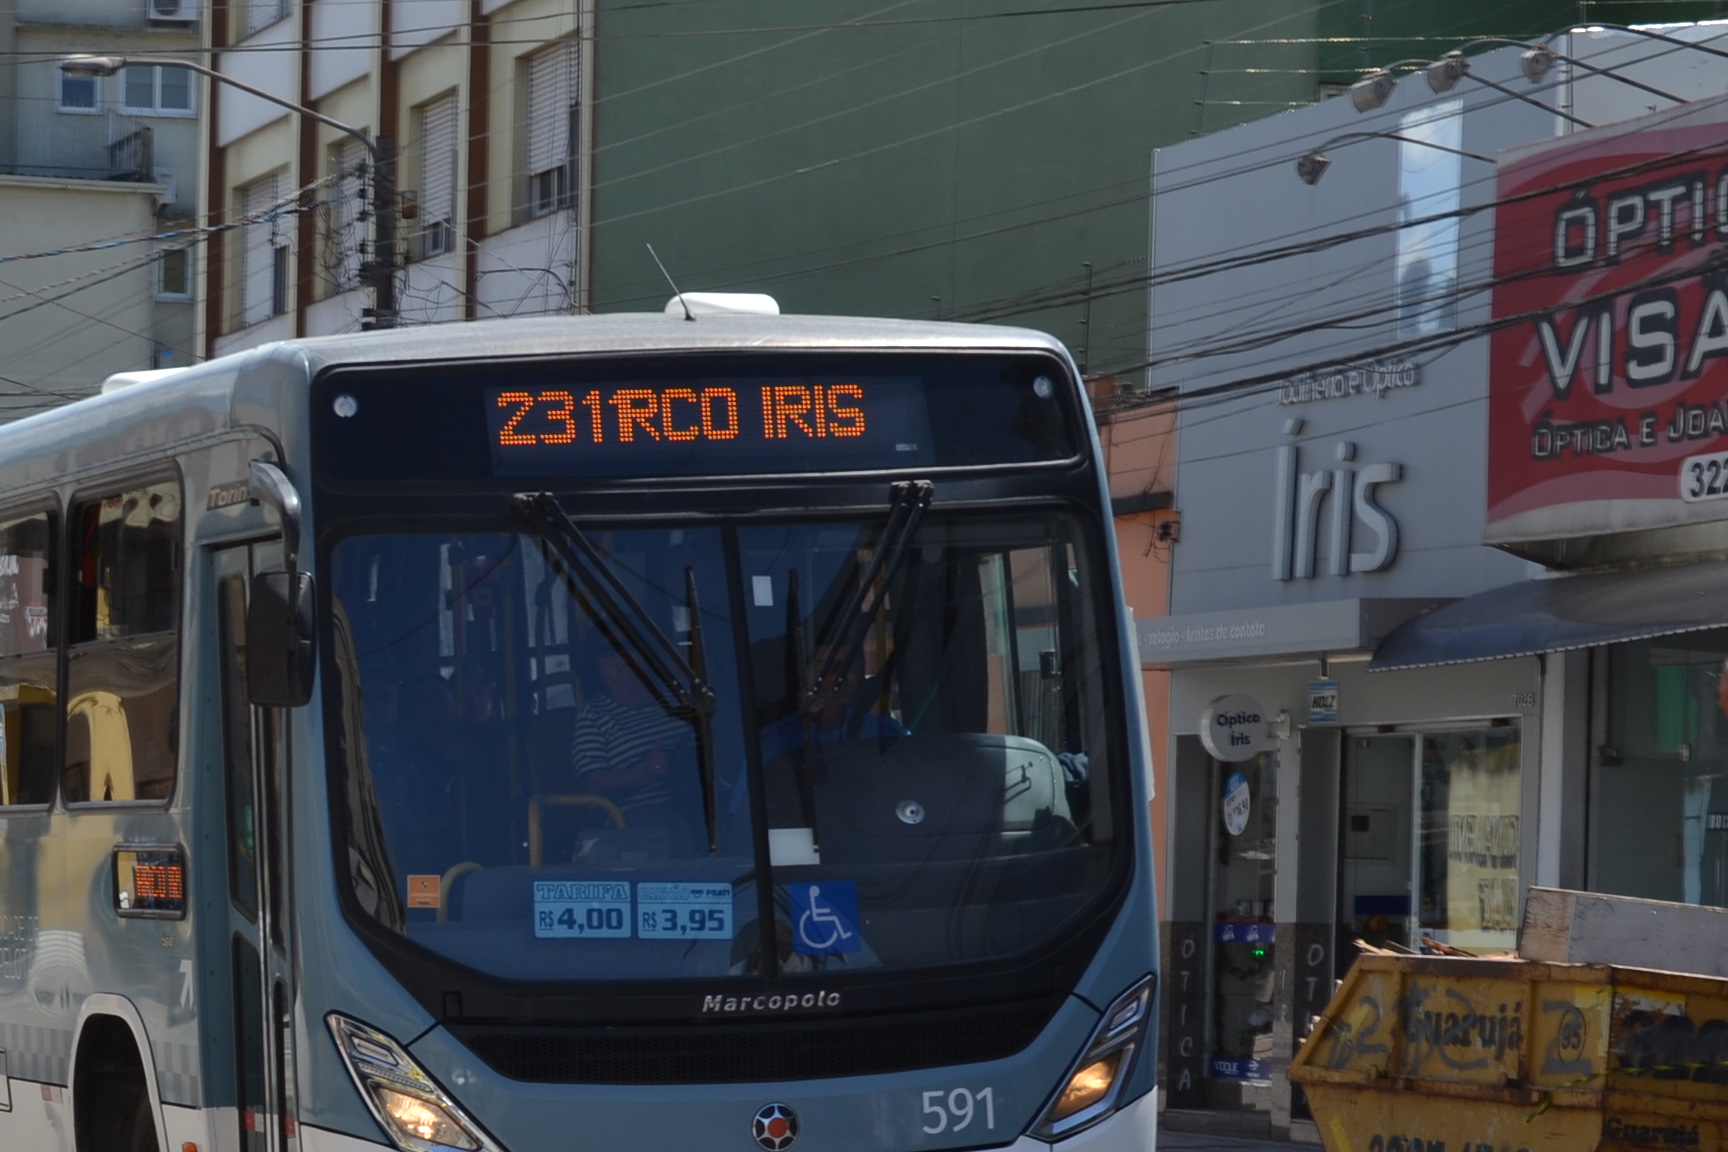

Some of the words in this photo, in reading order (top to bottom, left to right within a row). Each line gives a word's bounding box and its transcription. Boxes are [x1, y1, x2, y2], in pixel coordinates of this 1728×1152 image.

[761, 383, 866, 439] IRIS
[1668, 403, 1728, 442] JOA
[1216, 622, 1228, 640] de
[1230, 621, 1266, 639] contato
[535, 882, 628, 901] TARIFA
[538, 910, 555, 931] R$
[556, 907, 624, 935] 4,00
[641, 911, 658, 931] R$
[661, 908, 725, 936] 3,95
[702, 989, 841, 1013] Marcopolo
[921, 1086, 995, 1135] 591
